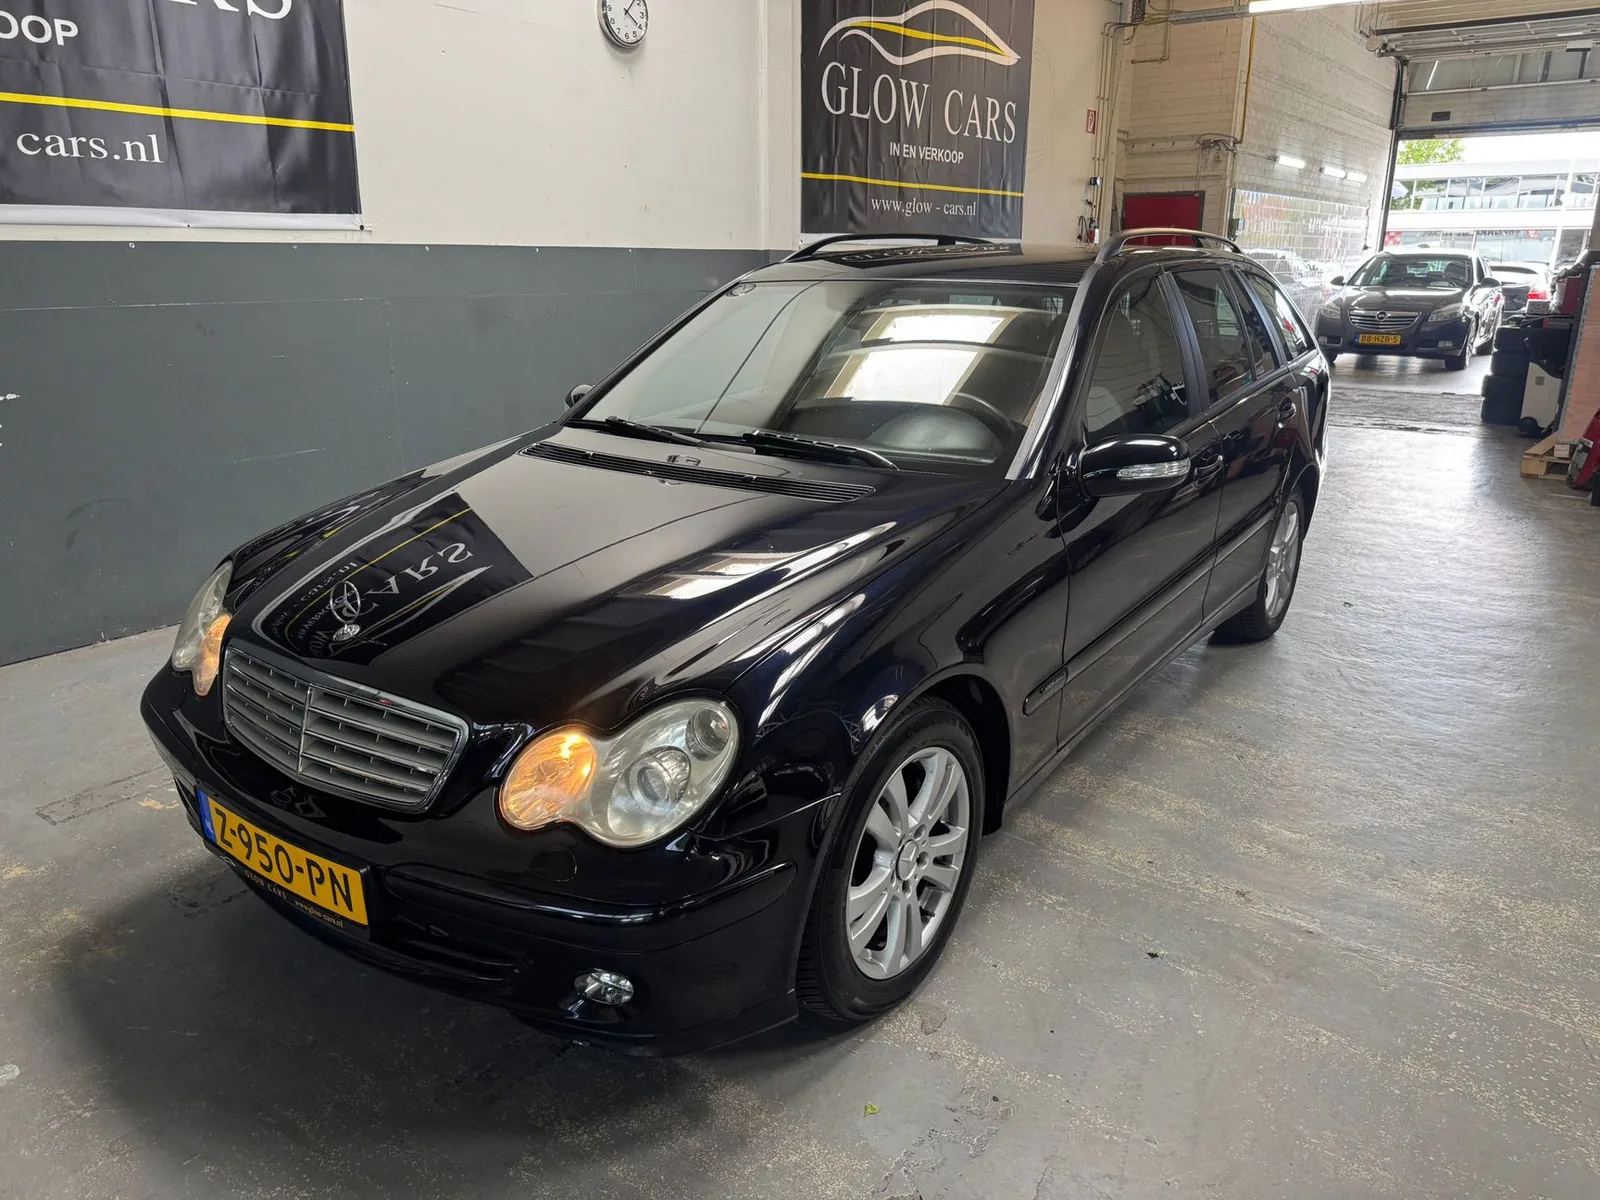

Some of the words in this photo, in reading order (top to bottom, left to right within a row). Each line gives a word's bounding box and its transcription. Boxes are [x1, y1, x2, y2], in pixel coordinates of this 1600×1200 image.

[821, 61, 930, 130] GLOW
[944, 89, 1018, 144] CARS
[16, 132, 164, 164] cars.nl
[889, 141, 900, 157] IN
[903, 144, 916, 160] EN
[919, 146, 964, 164] VERKOOP
[943, 201, 976, 216] cars.nl
[214, 807, 354, 913] Z-950-PN
